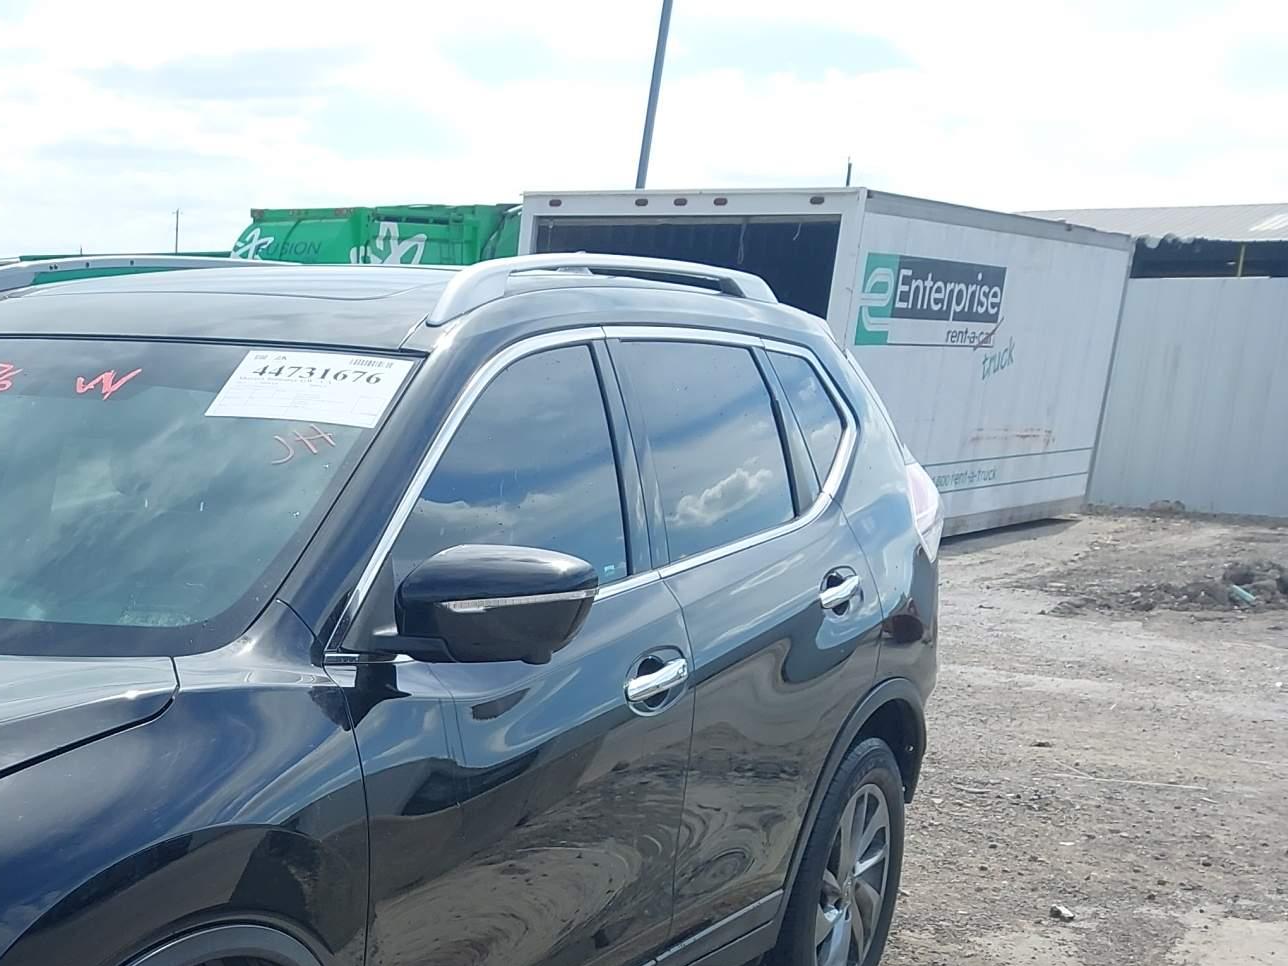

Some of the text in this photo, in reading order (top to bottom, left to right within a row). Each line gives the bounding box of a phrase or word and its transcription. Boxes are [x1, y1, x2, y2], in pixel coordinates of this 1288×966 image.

[894, 268, 1001, 322] Enterprise
[253, 364, 385, 385] 44731676
[982, 336, 1015, 380] truck
